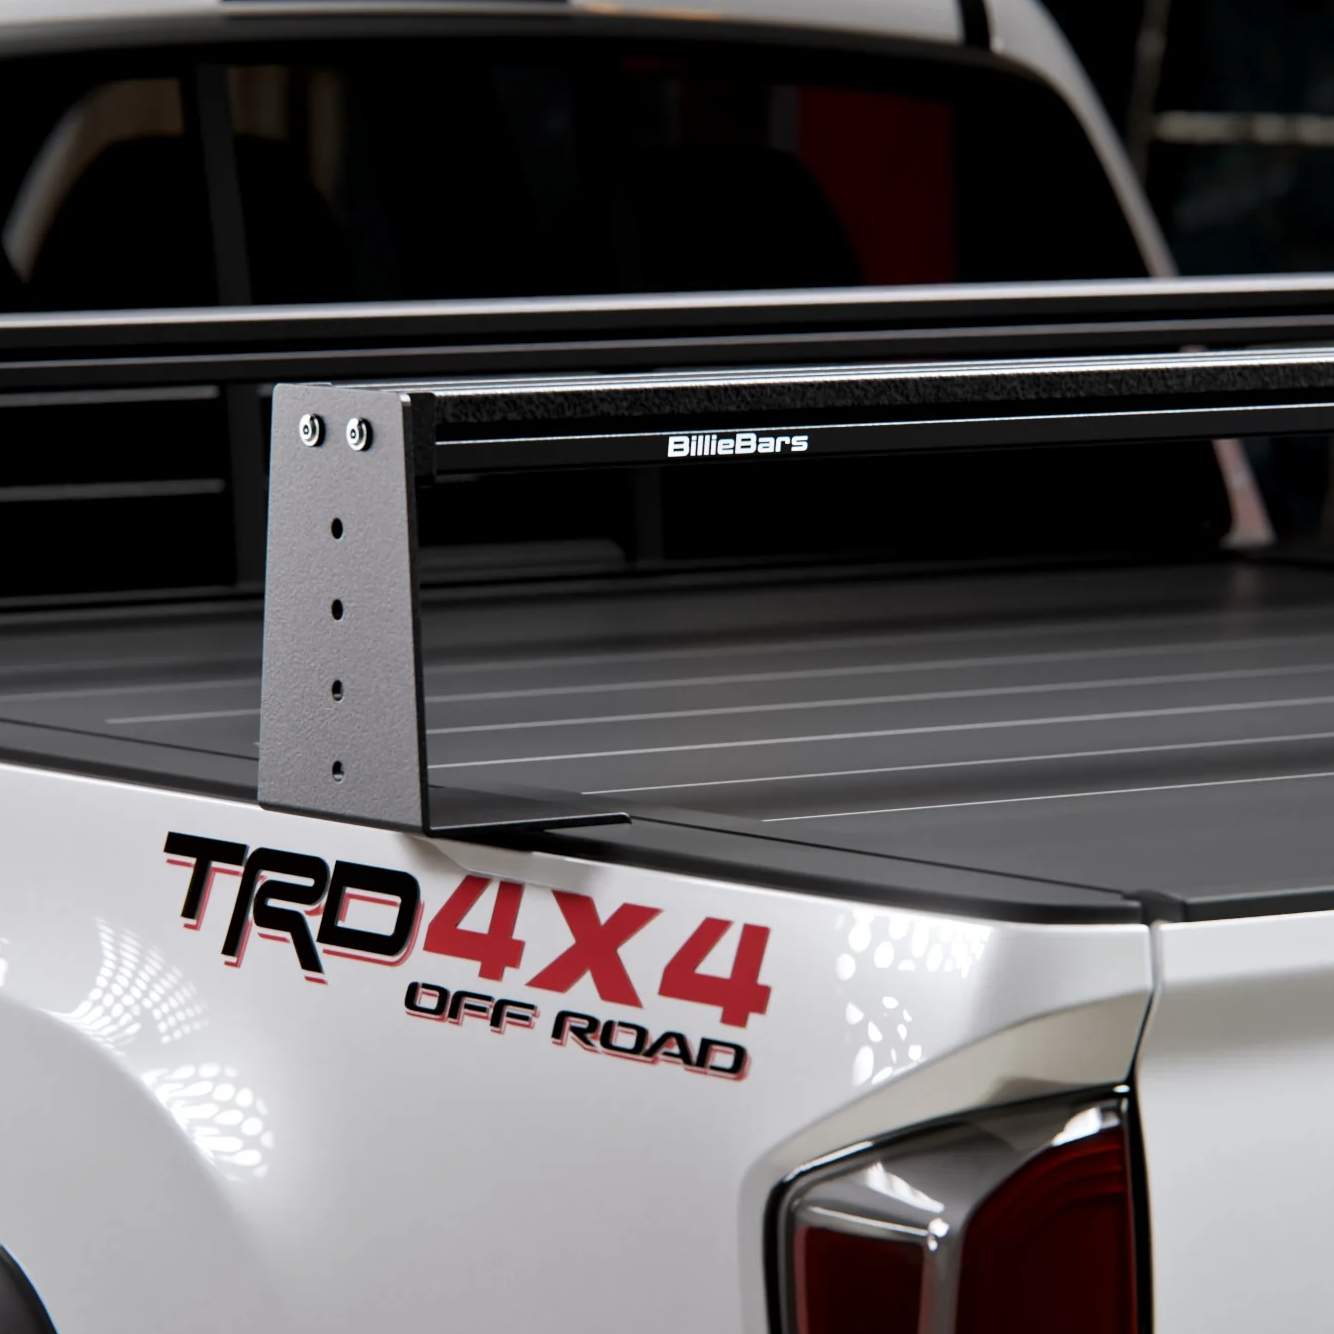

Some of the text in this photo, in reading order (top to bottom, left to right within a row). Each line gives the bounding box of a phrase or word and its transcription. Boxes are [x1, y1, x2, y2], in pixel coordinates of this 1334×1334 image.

[667, 433, 809, 458] BillieBars
[404, 981, 753, 1081] OFF ROAD
